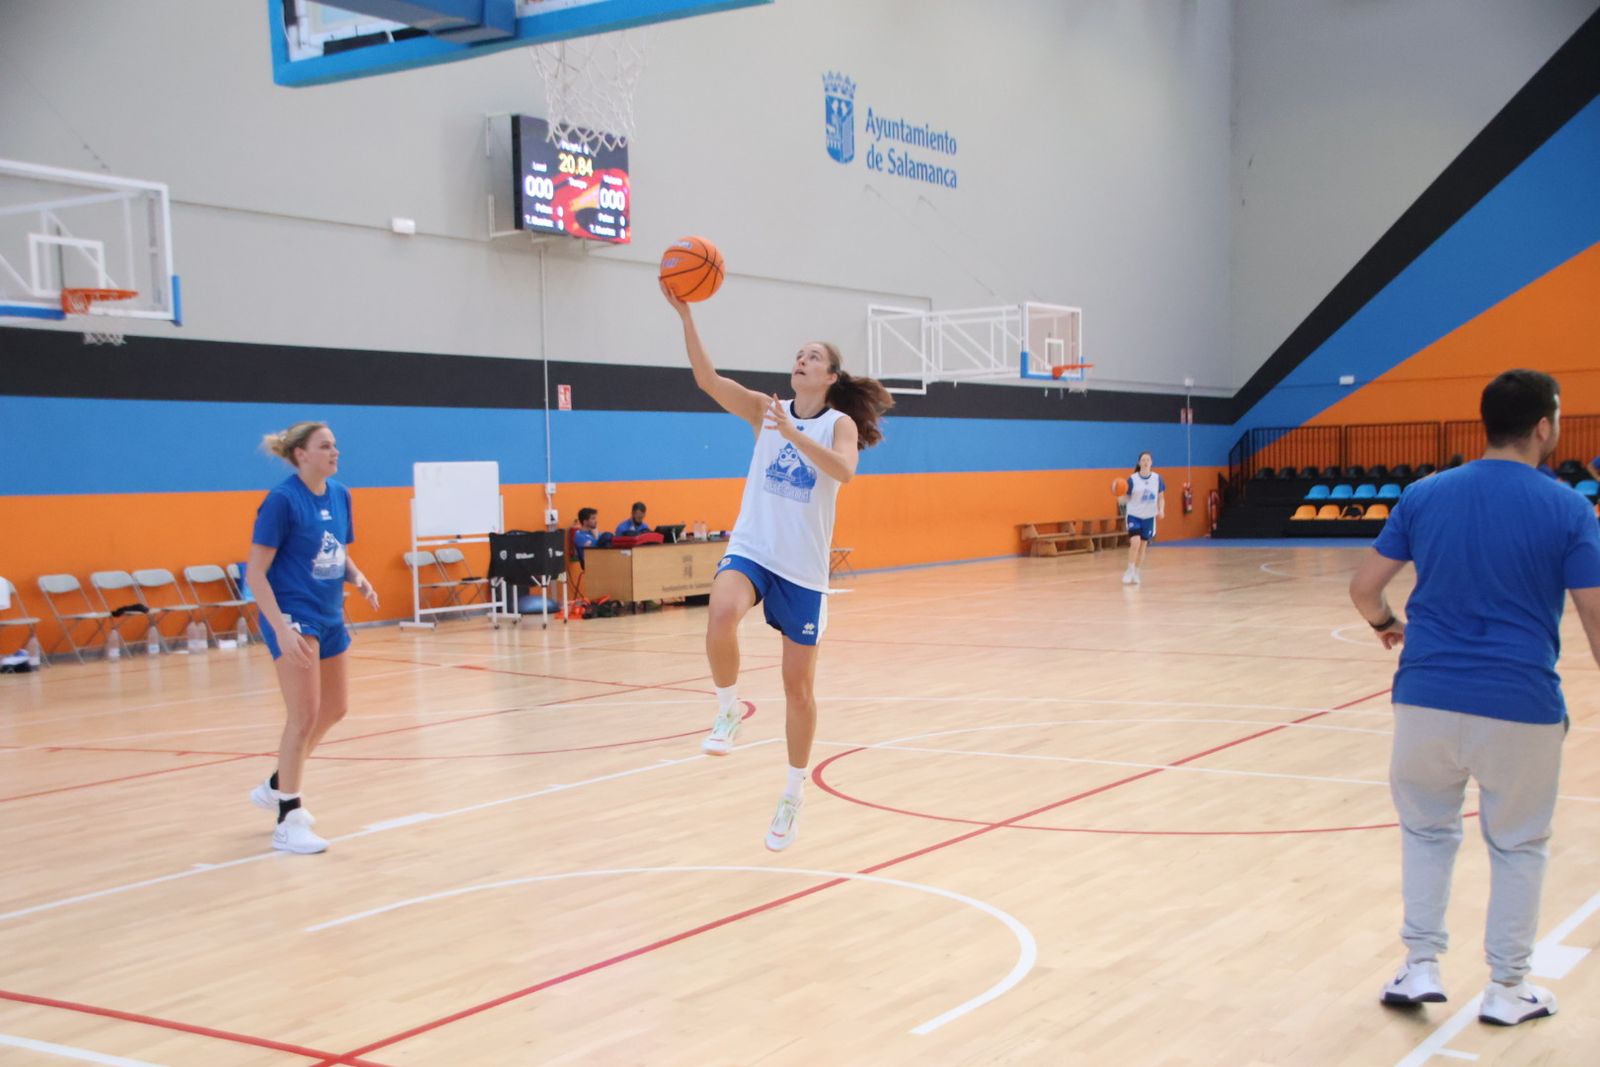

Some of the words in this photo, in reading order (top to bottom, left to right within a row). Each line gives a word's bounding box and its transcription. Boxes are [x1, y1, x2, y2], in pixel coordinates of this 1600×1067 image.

[866, 107, 957, 155] Ayuntamiento
[558, 153, 593, 177] 20.84
[866, 144, 883, 172] de
[887, 147, 957, 189] Salamanca
[525, 175, 553, 200] 000
[600, 187, 625, 211] 000
